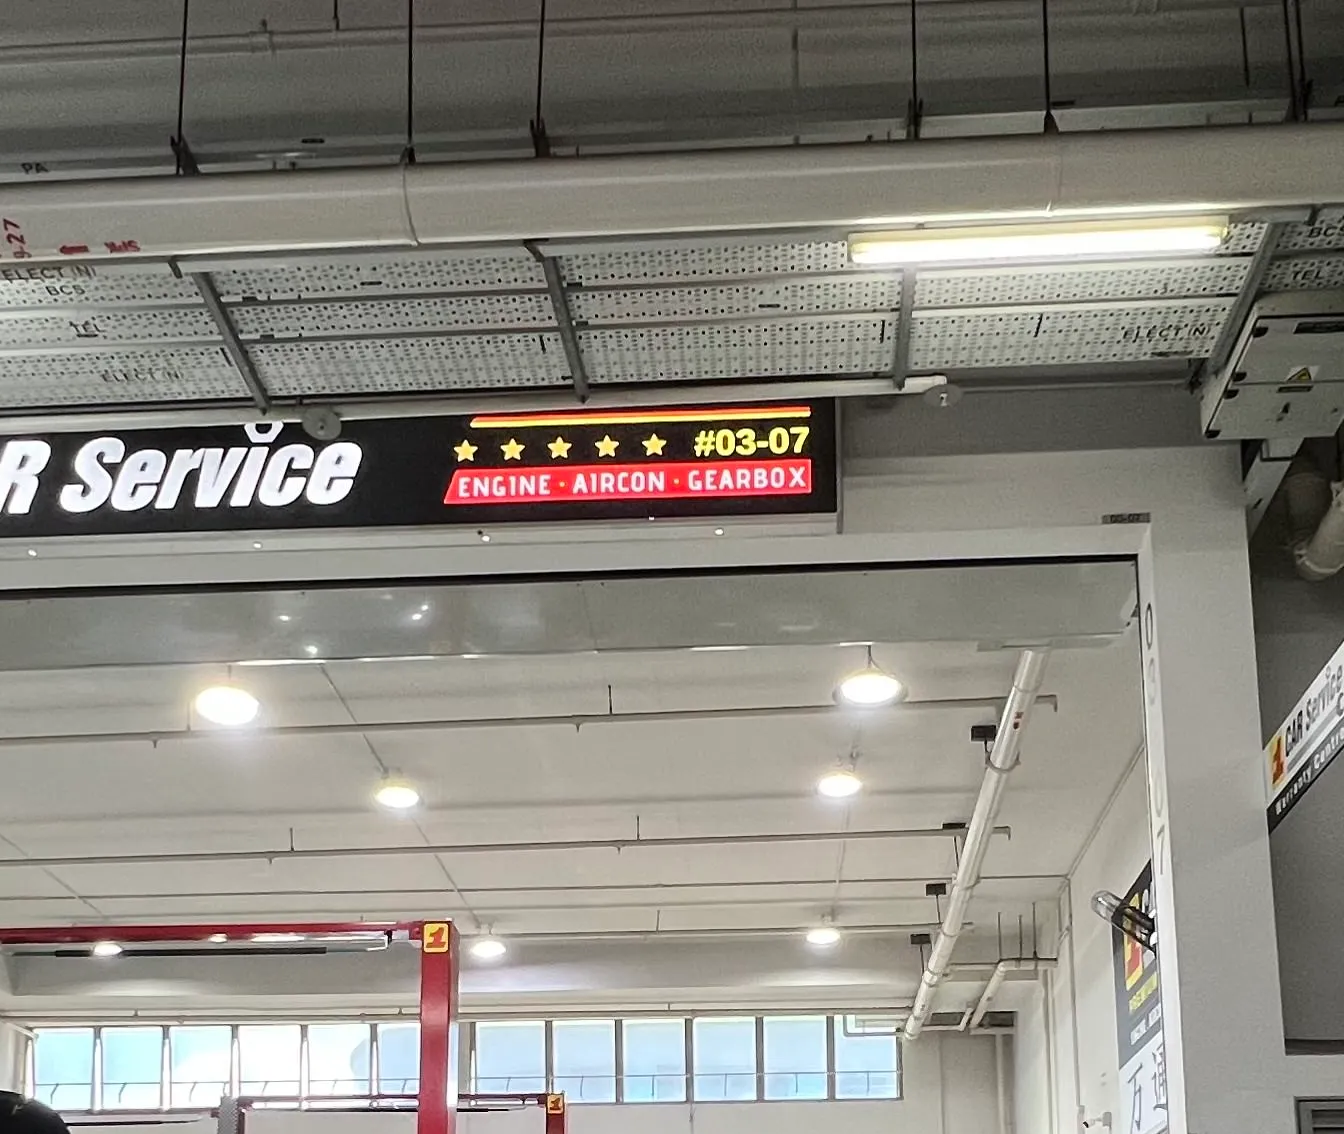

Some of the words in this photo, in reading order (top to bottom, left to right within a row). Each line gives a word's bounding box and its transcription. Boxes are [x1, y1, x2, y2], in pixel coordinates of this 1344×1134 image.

[20, 162, 49, 175] PA
[693, 426, 811, 457] #03-07
[59, 422, 363, 513] Service
[458, 475, 551, 498] ENGINE
[572, 471, 666, 494] AIRCON
[687, 465, 807, 490] GEARBOX
[1285, 710, 1304, 759] CAR
[1305, 664, 1343, 732] Service
[1275, 763, 1312, 815] Warranty
